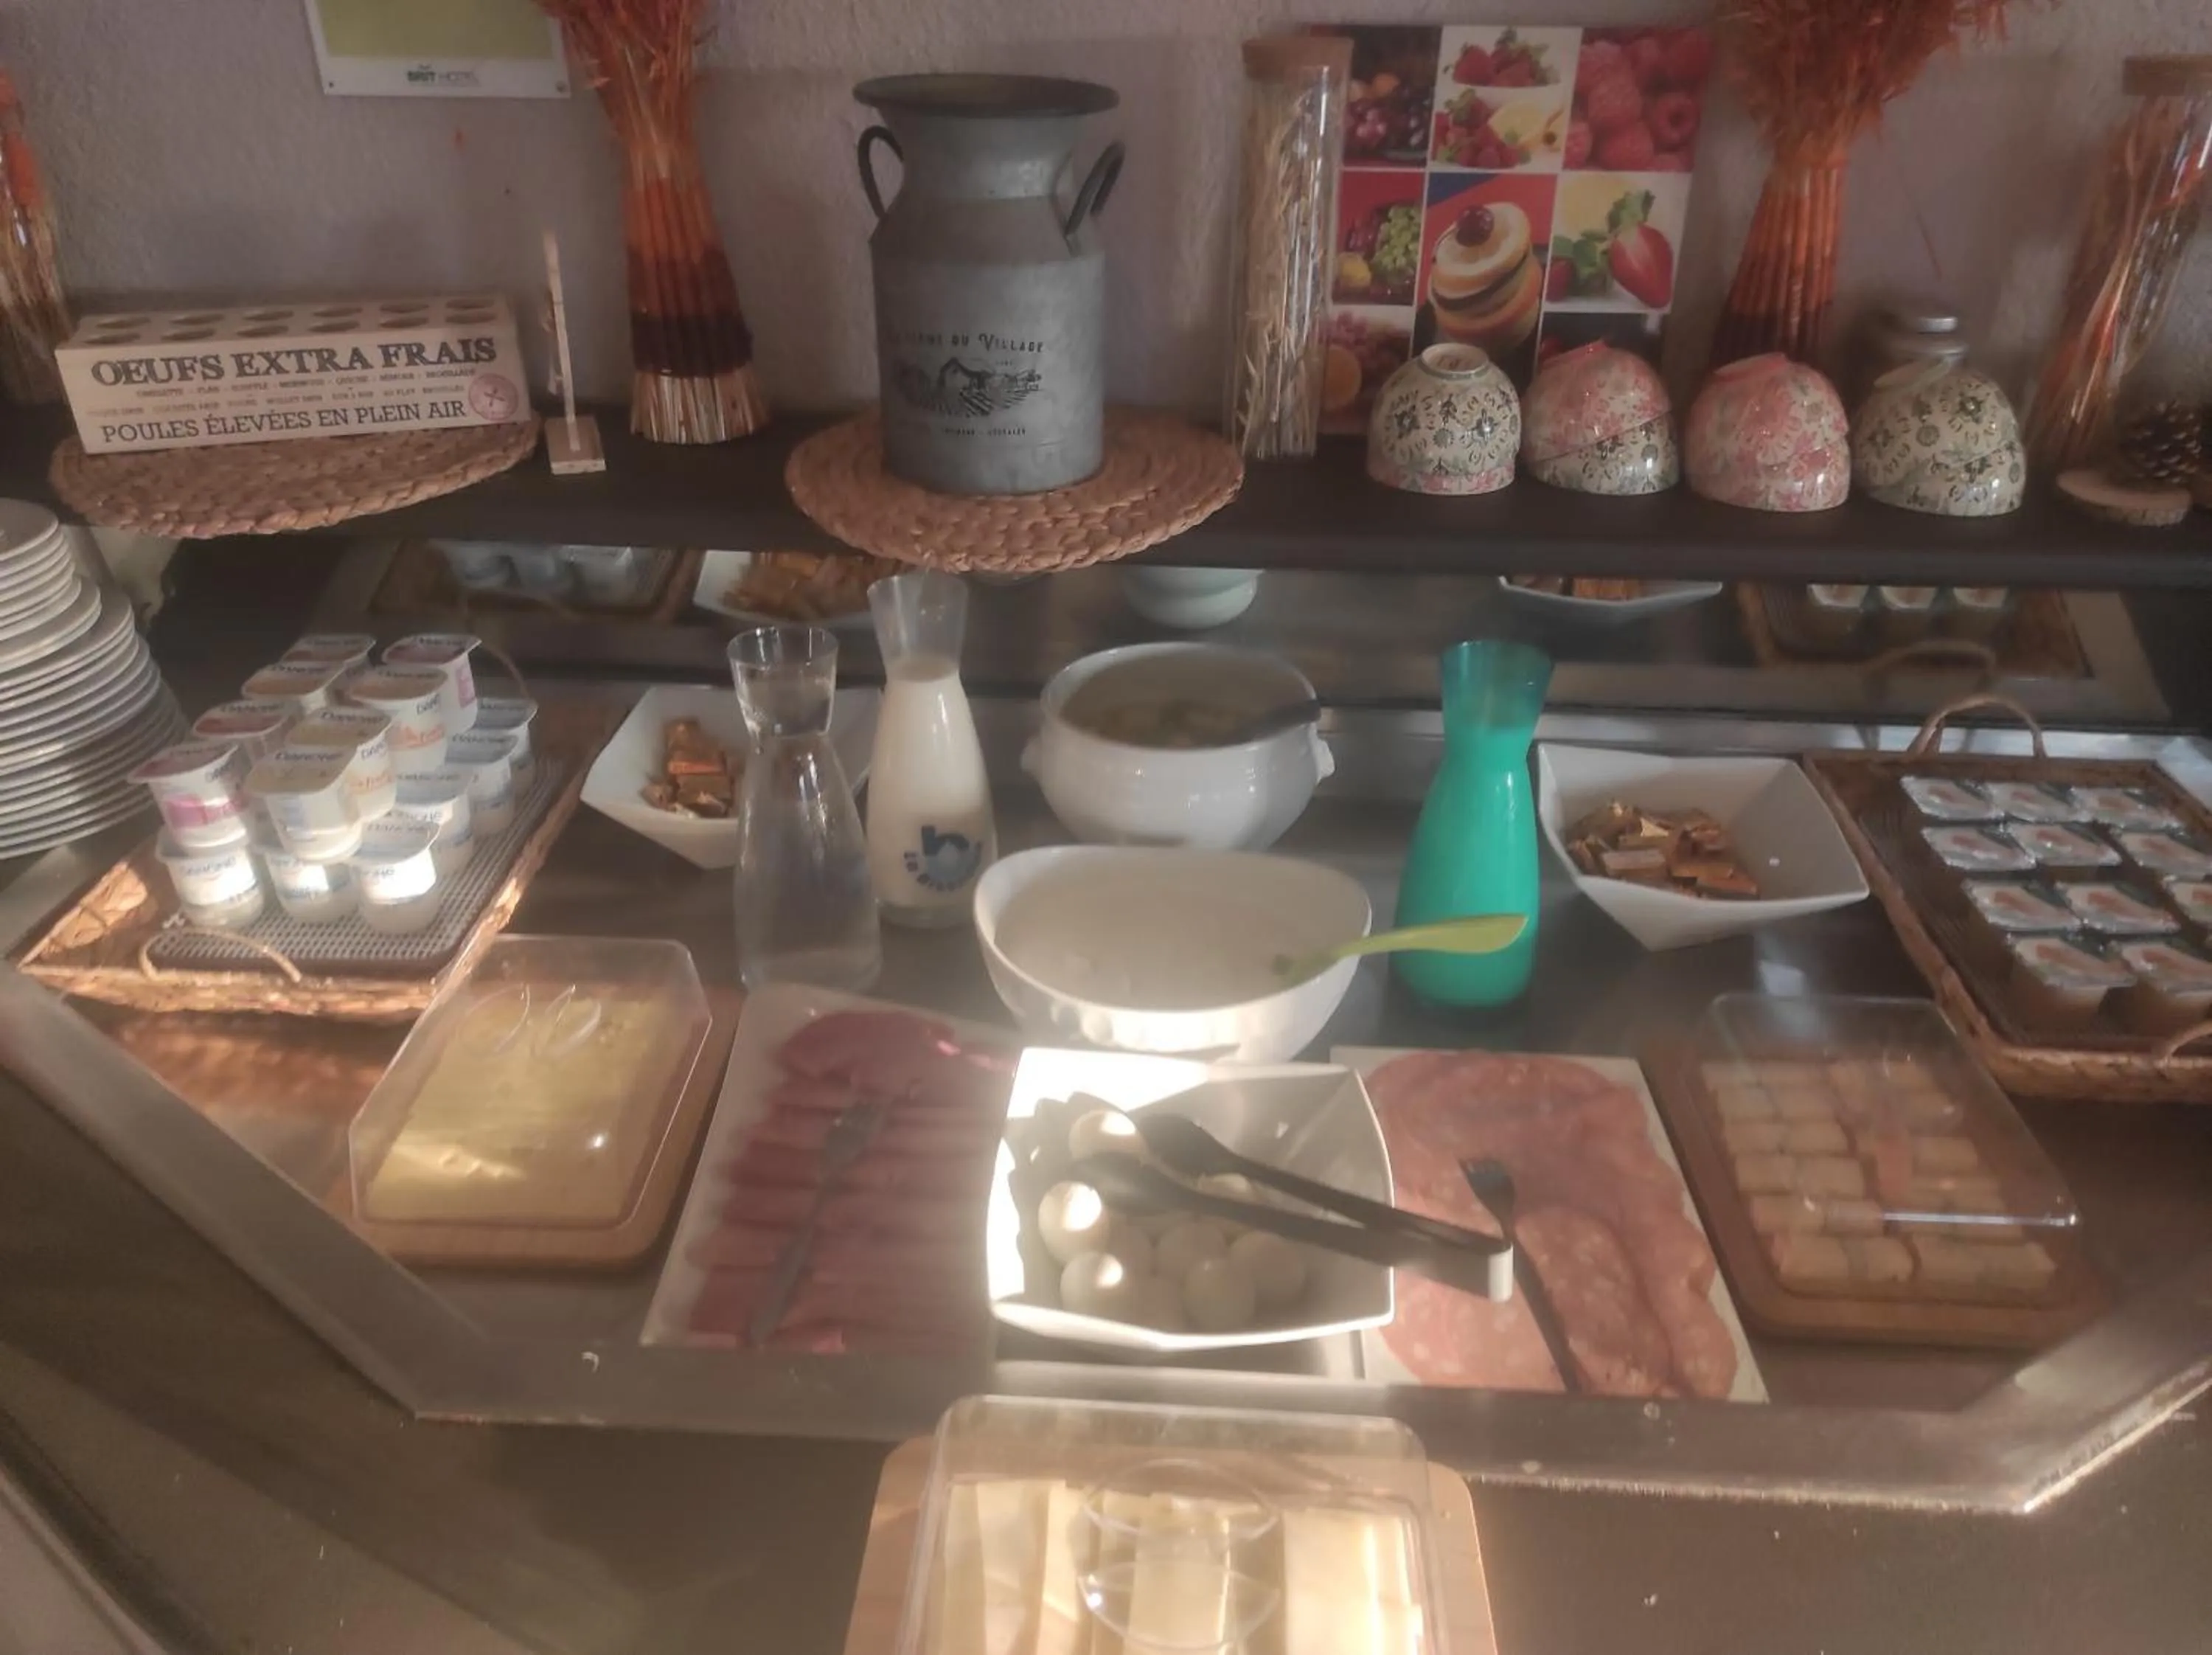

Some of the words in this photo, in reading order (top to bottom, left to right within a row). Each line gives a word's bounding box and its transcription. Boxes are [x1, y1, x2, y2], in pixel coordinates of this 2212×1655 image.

[230, 347, 374, 378] EXTRA
[378, 337, 497, 368] FRAIS
[102, 419, 199, 443] POULES
[204, 409, 312, 435] ÉLEVÉES
[318, 408, 350, 426] EN
[356, 403, 420, 423] PLEIN
[428, 400, 467, 418] AIR
